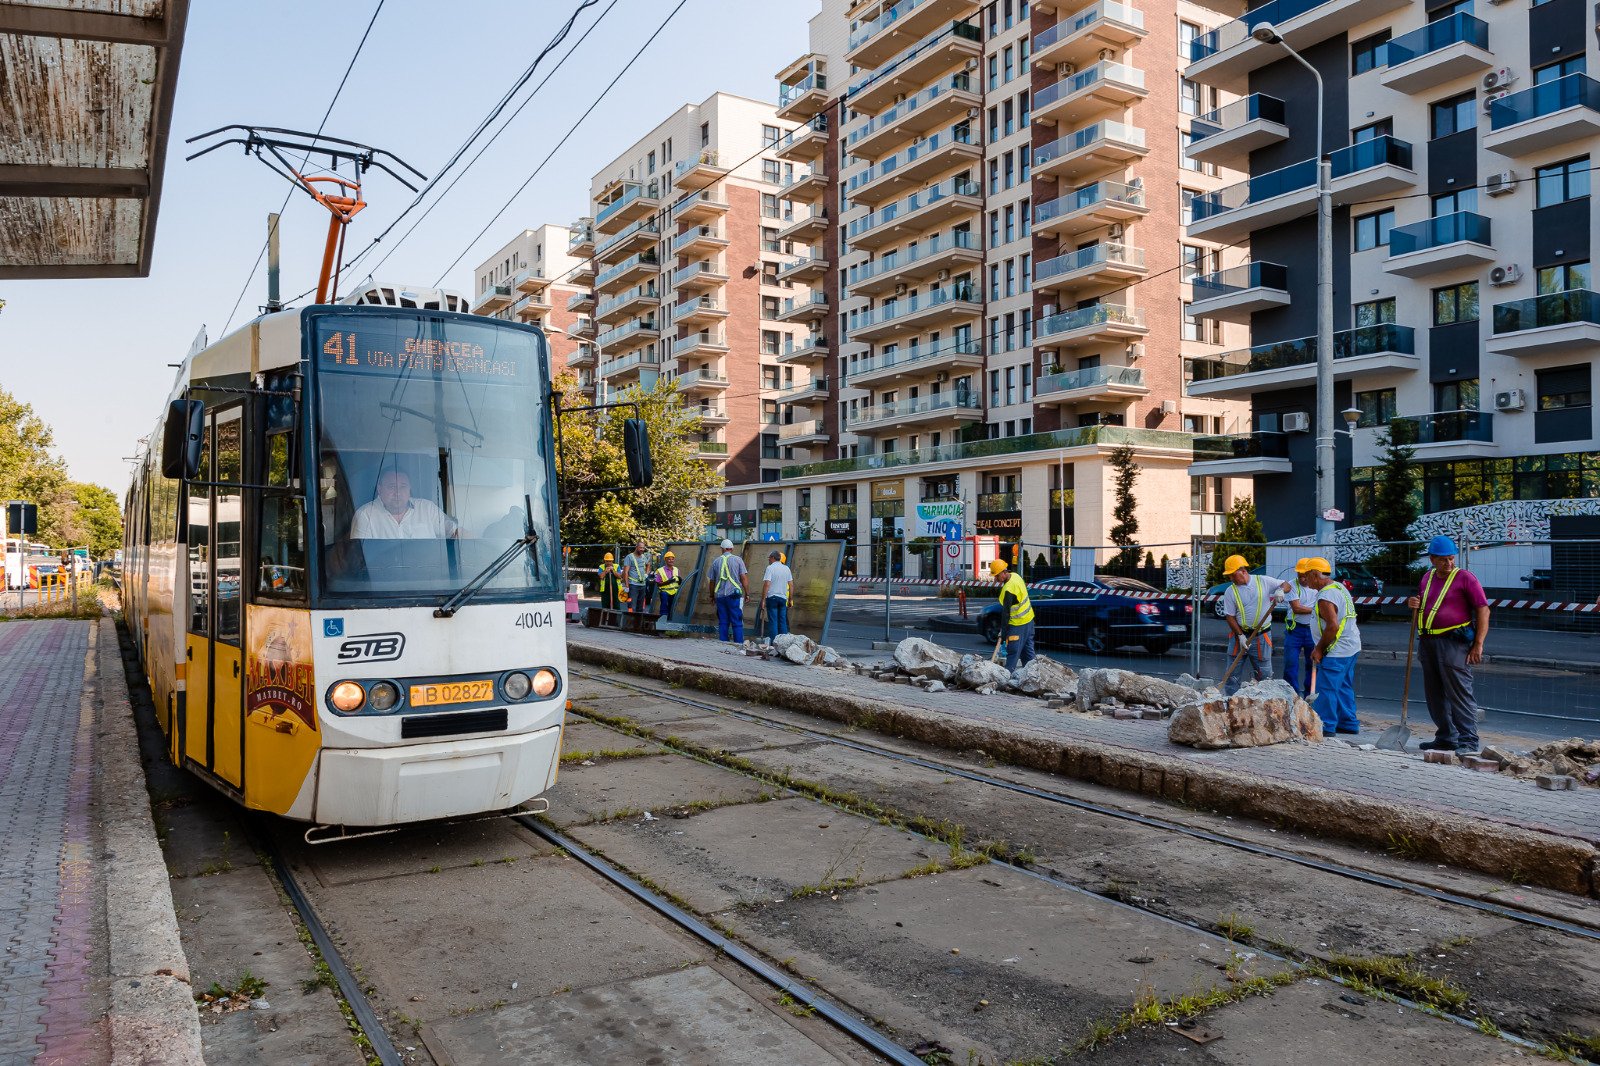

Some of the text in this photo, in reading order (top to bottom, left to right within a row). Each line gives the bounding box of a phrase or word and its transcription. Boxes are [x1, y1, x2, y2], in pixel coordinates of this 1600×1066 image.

[323, 332, 358, 365] 41
[405, 337, 484, 359] GHENCEA
[367, 350, 393, 368] VIA
[398, 353, 443, 371] PIATA
[922, 504, 961, 516] FARMACIA
[926, 521, 953, 534] TINO
[993, 518, 1021, 528] CONCEPT
[950, 546, 957, 555] 10
[515, 611, 552, 629] 4004
[337, 637, 399, 659] STB
[246, 655, 315, 706] MAXBET
[256, 690, 303, 711] MAXBET.RO
[426, 683, 490, 703] B 02827
